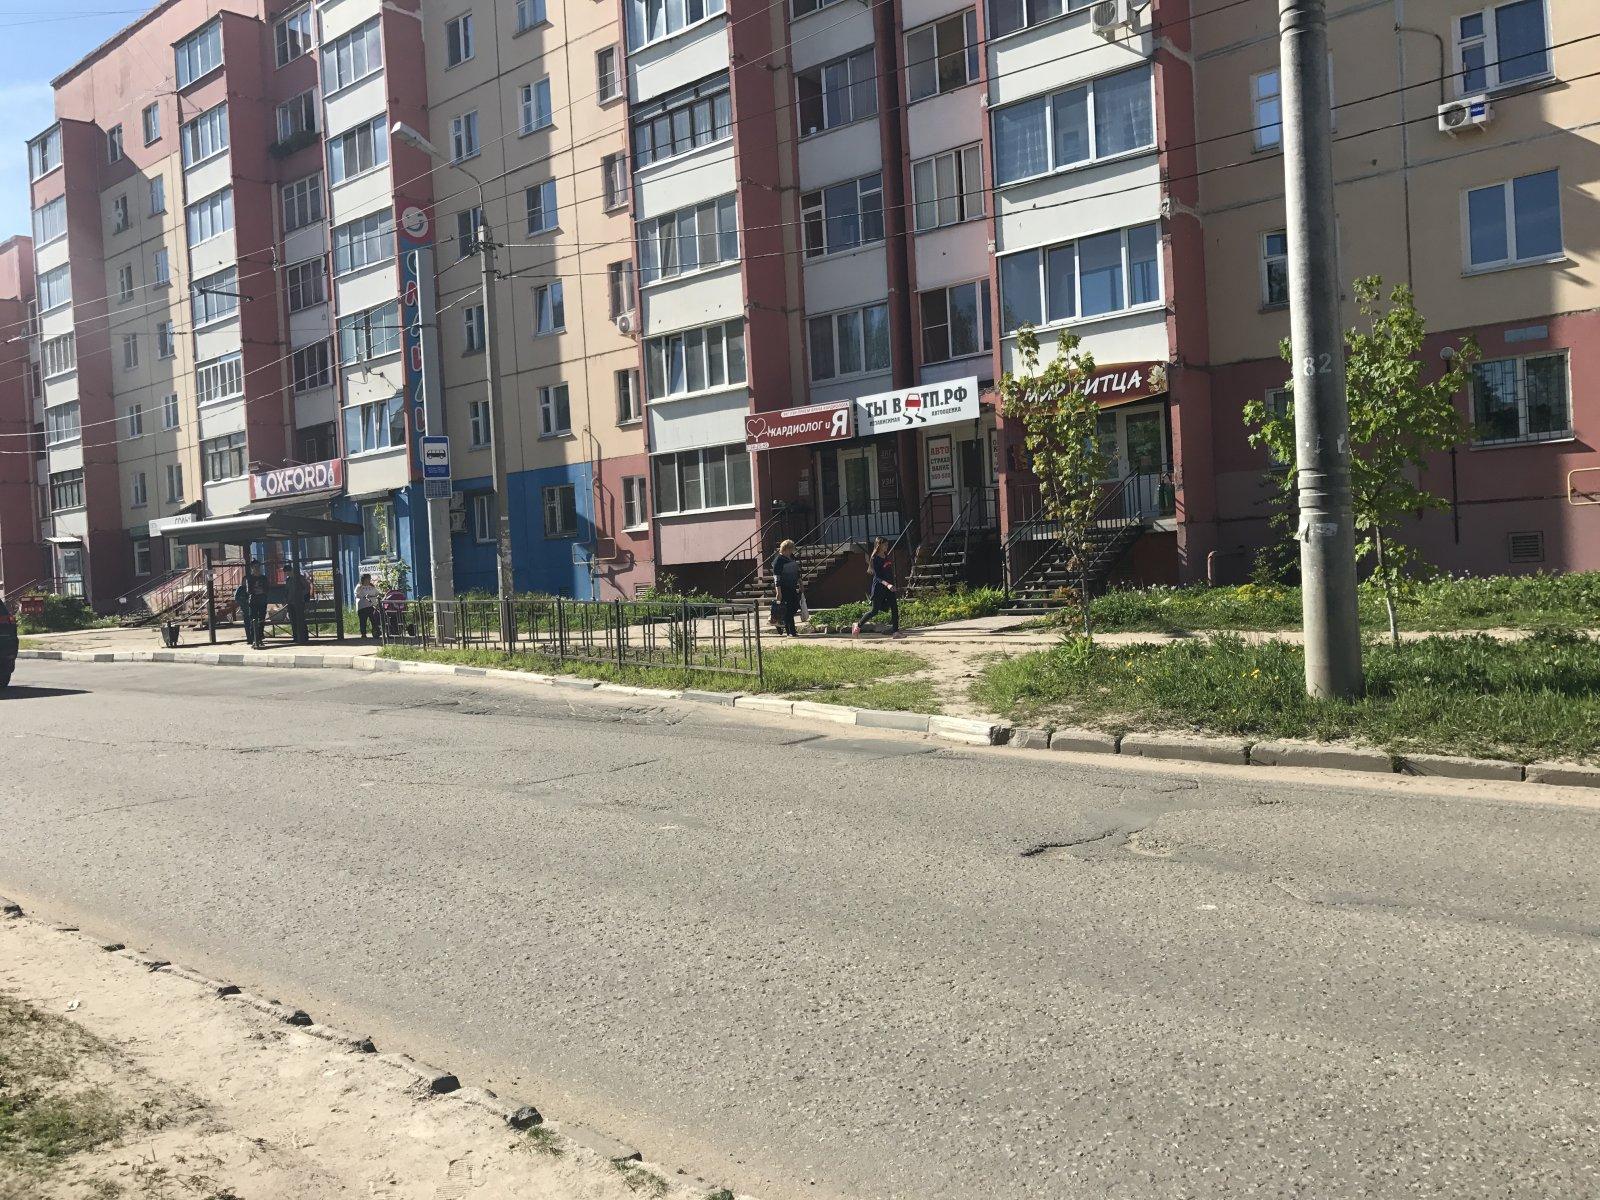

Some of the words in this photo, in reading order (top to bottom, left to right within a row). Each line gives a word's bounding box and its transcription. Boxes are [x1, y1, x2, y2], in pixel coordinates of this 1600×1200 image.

[865, 400, 887, 418] ТЫ
[892, 398, 902, 414] В
[769, 421, 823, 437] КАРДИОЛОГ
[830, 409, 848, 437] Я
[266, 464, 327, 495] OXFORD
